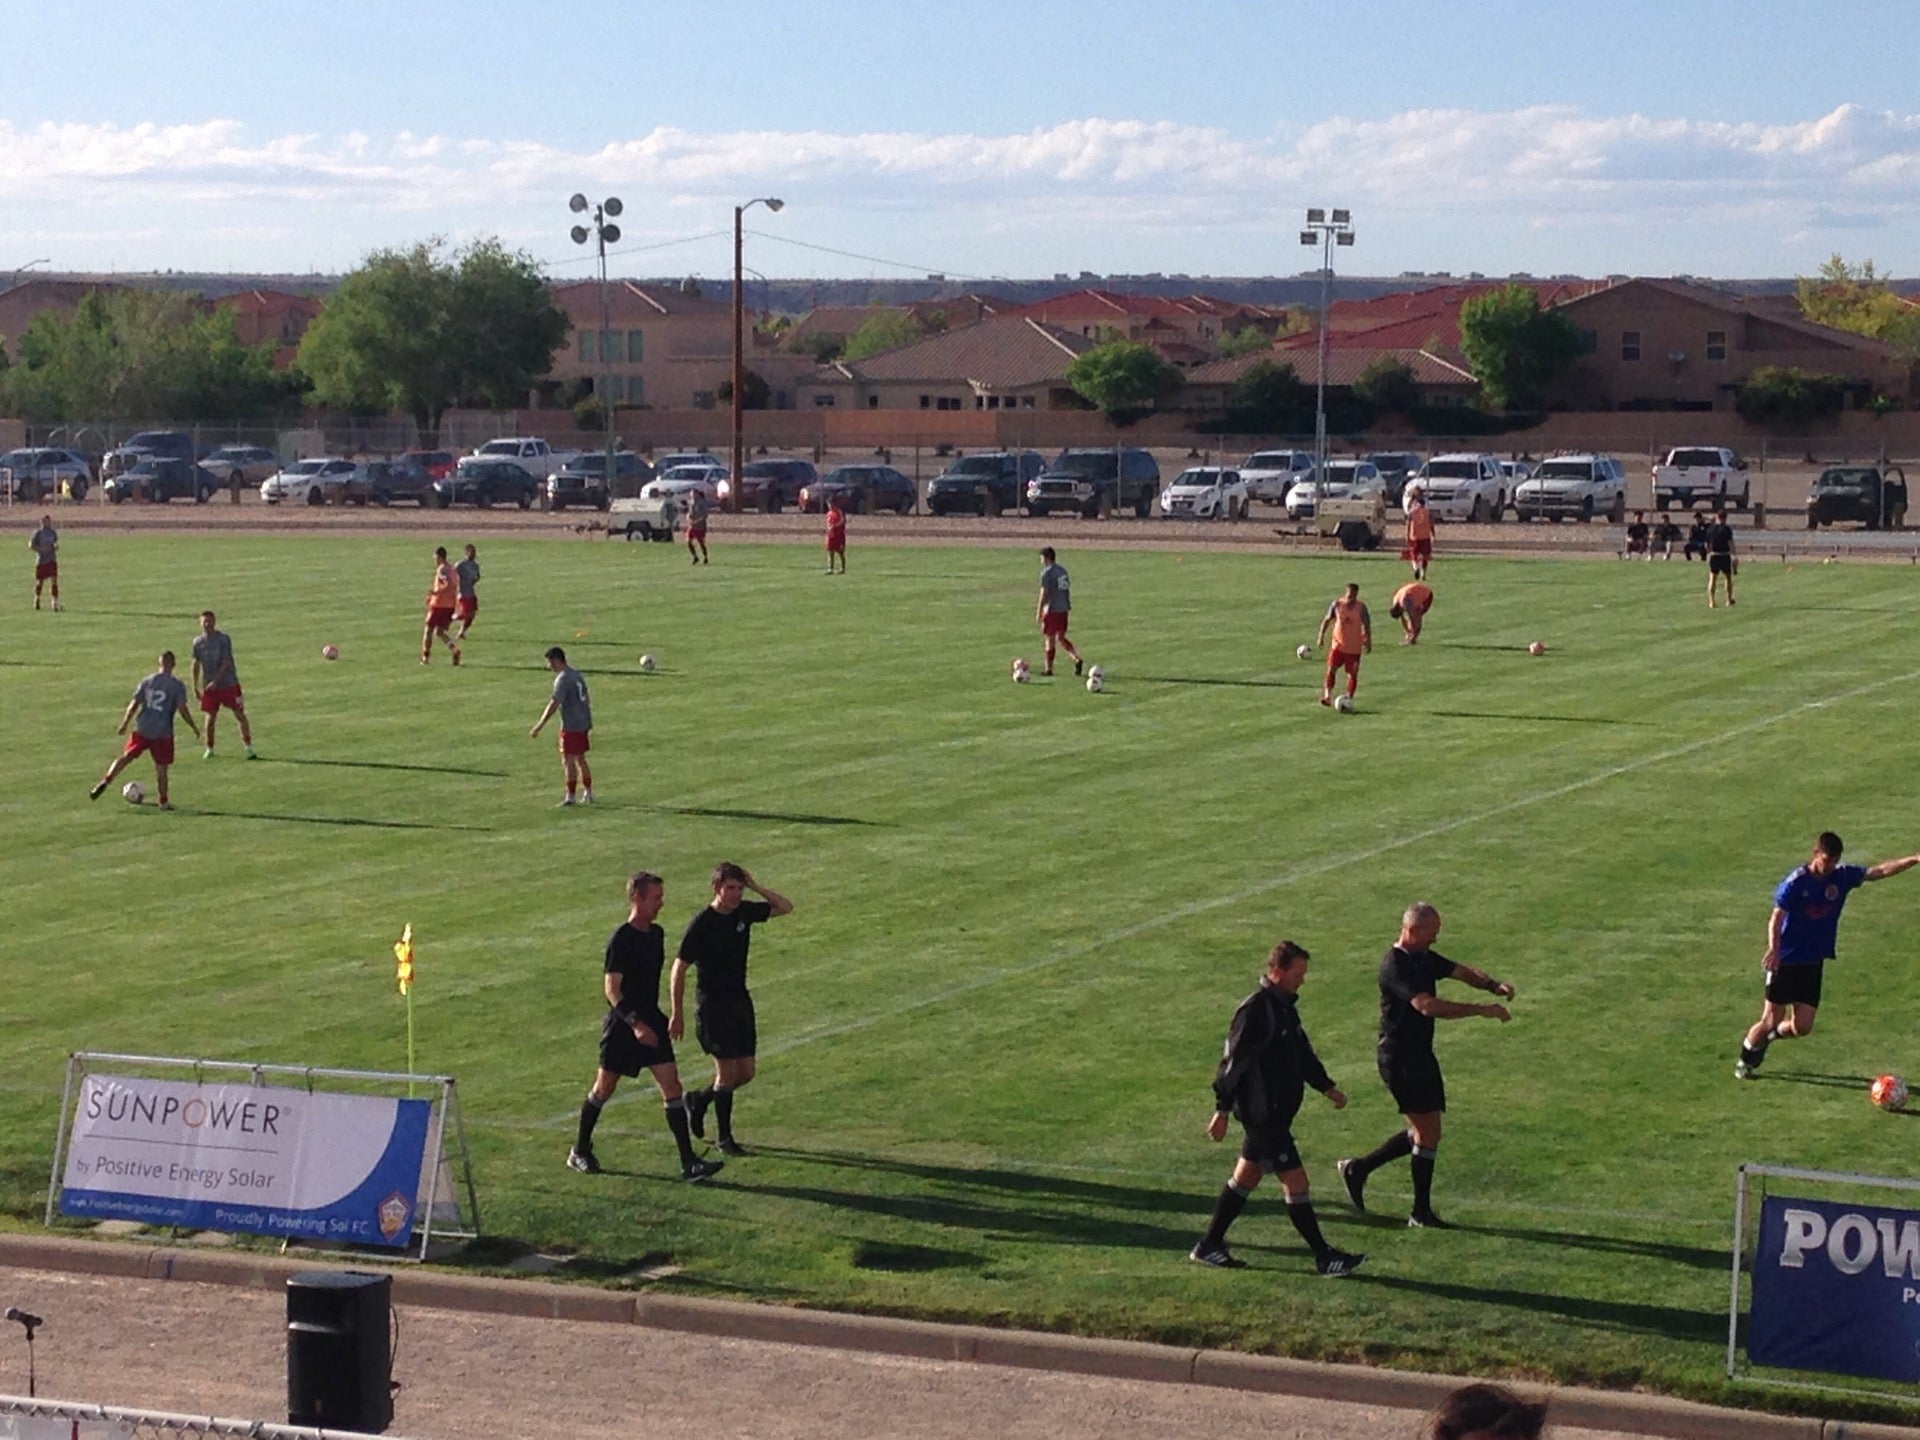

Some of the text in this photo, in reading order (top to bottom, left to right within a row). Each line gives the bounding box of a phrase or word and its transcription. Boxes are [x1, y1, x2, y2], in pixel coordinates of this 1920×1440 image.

[144, 687, 166, 711] 12
[87, 1089, 280, 1135] SUNPOWER
[76, 1156, 275, 1189] by Positive Energy Solar
[215, 1208, 264, 1229] Proudly
[268, 1213, 327, 1235] Powering
